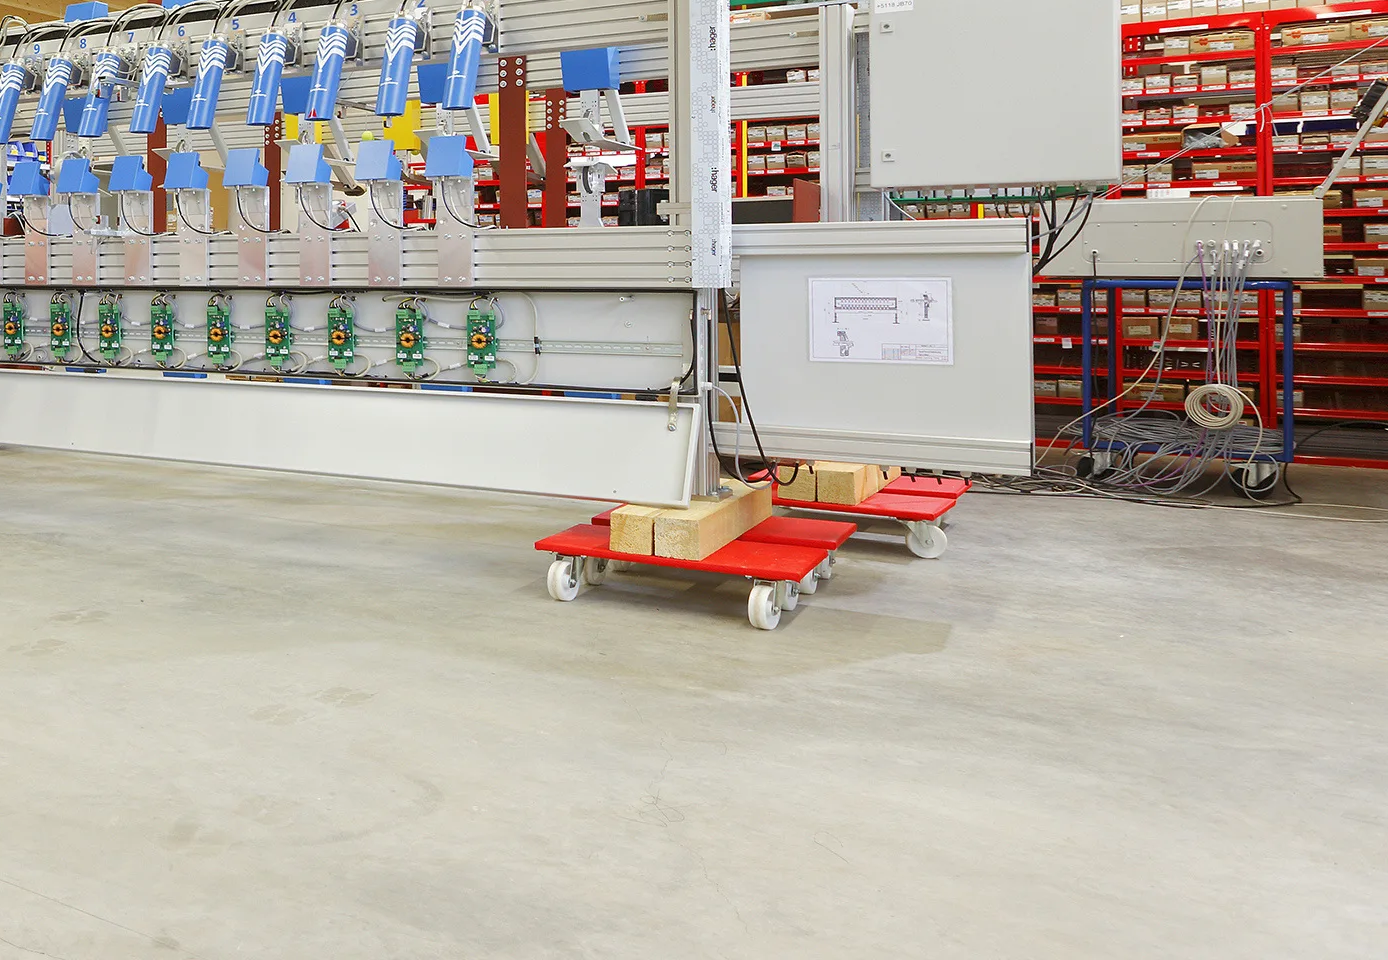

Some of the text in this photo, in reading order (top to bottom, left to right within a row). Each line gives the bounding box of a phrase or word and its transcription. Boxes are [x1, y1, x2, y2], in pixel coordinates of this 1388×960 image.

[350, 4, 358, 16] 3
[288, 12, 297, 23] 4
[232, 19, 240, 30] 5
[177, 25, 185, 37] 6
[127, 32, 134, 43] 7
[34, 44, 41, 54] 9
[79, 38, 87, 49] 8
